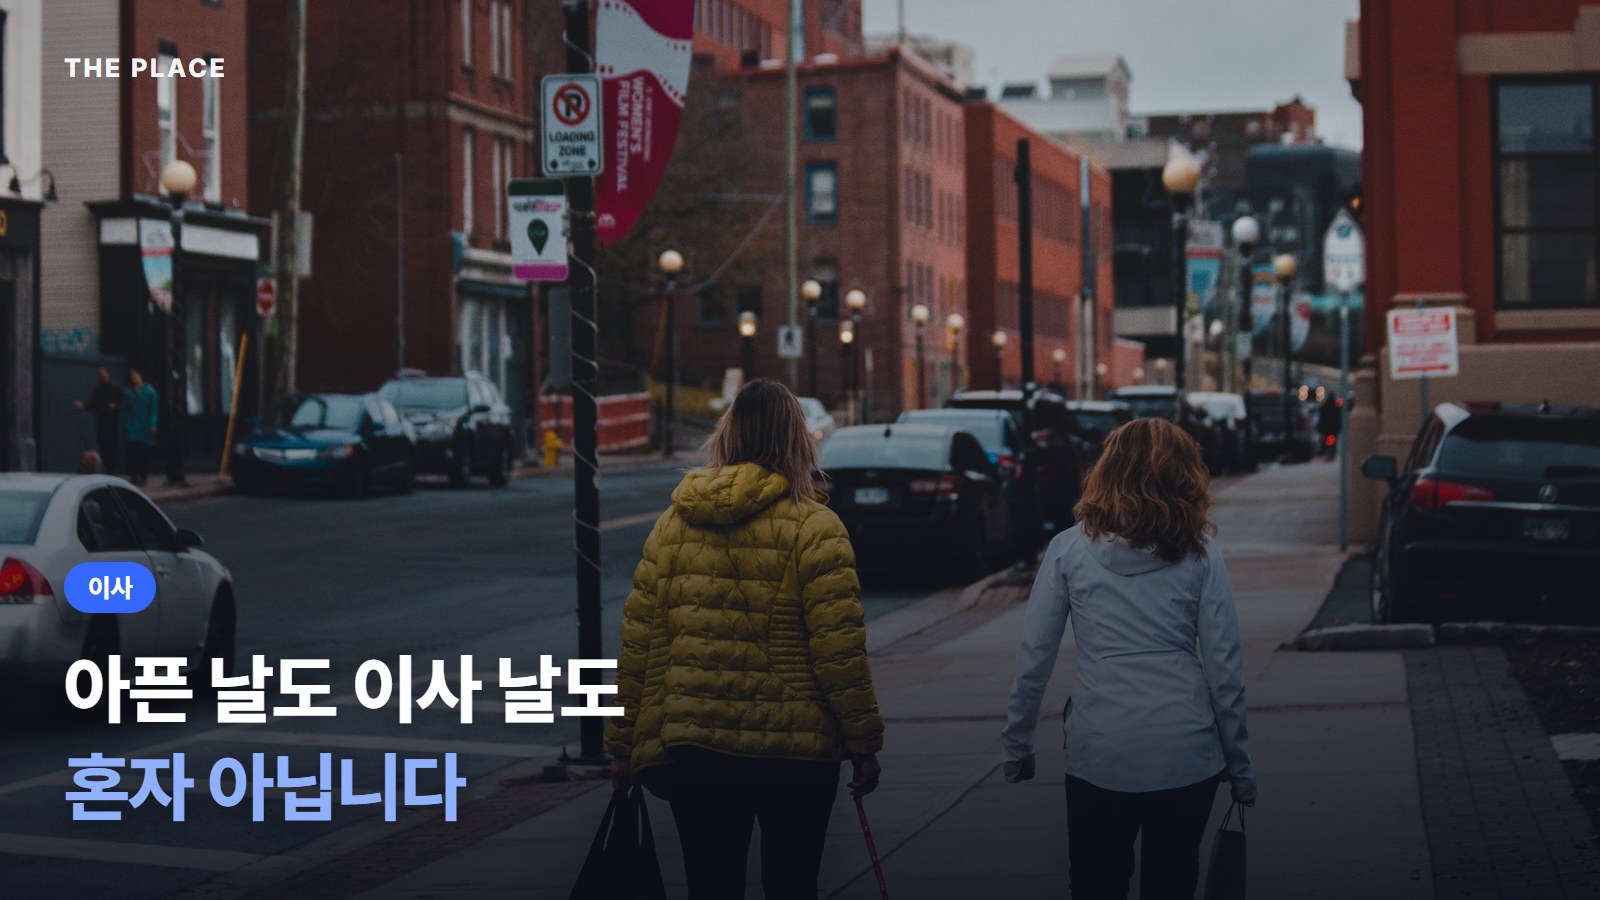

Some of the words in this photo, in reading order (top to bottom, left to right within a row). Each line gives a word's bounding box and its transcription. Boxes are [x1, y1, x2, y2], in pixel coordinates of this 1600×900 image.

[617, 79, 630, 118] FILM
[630, 76, 645, 154] WOMEN'S
[548, 131, 595, 142] LOADING
[558, 145, 586, 156] ZONE
[616, 120, 630, 194] FESTIVAL
